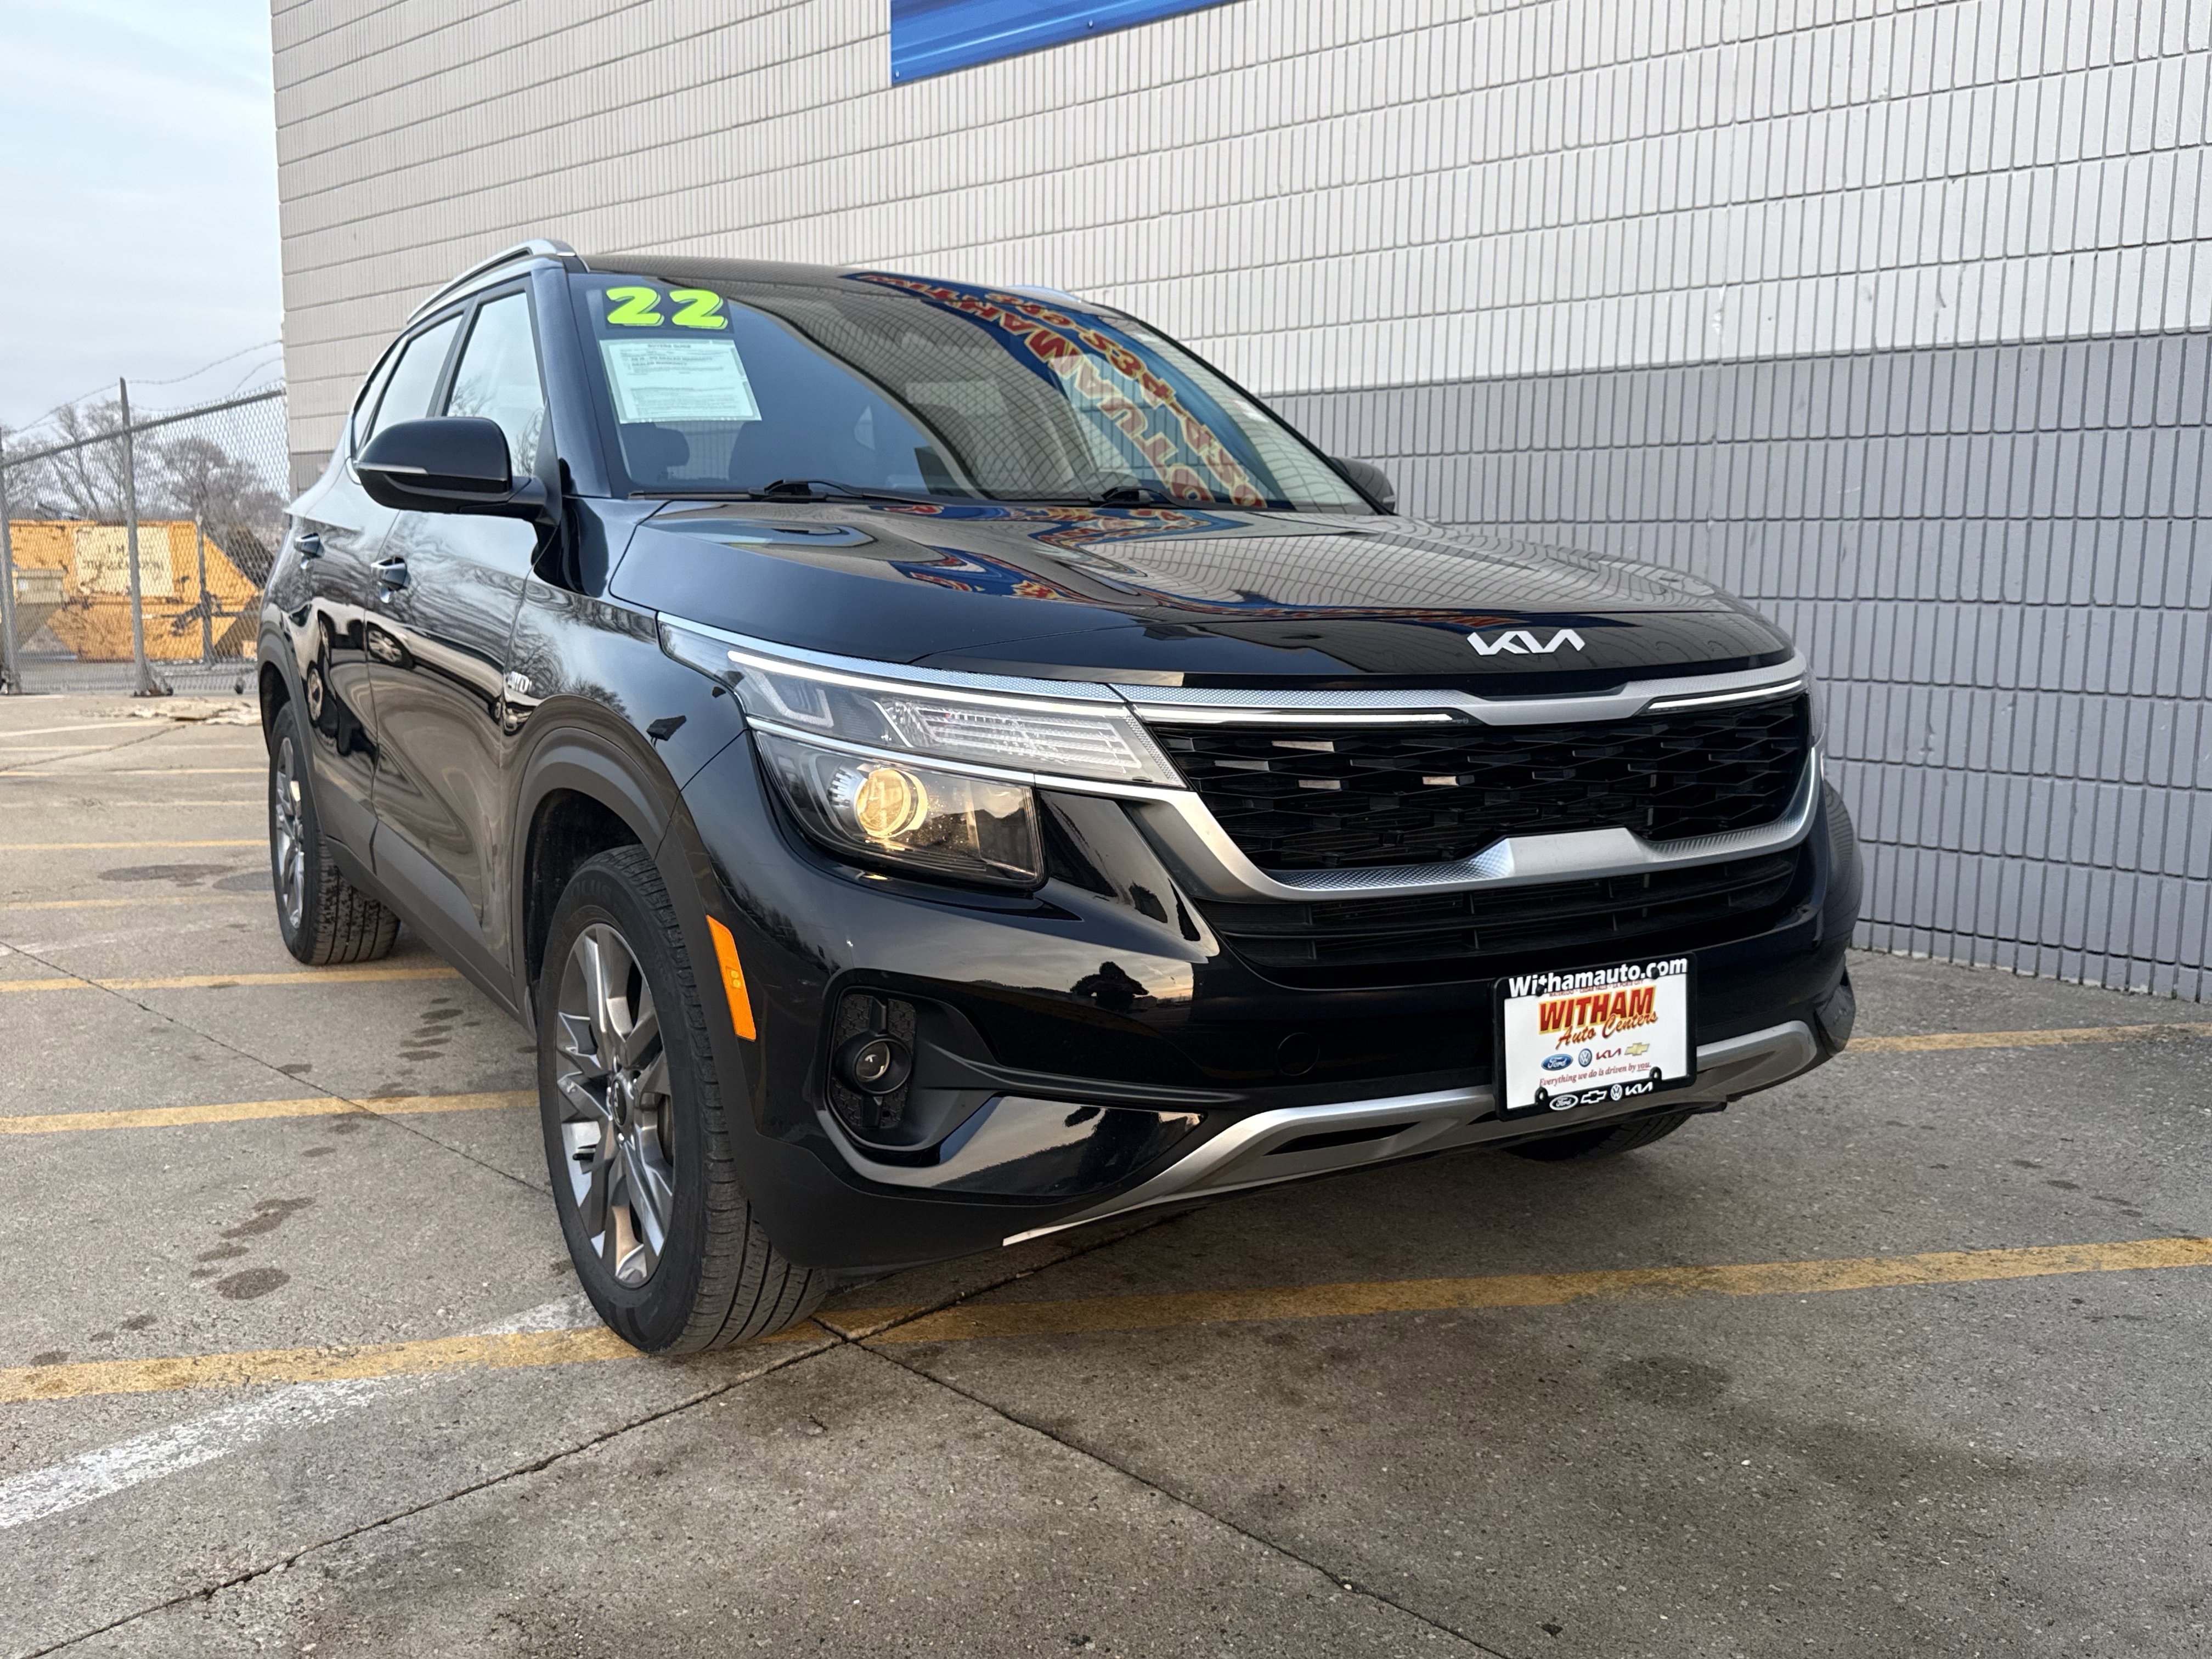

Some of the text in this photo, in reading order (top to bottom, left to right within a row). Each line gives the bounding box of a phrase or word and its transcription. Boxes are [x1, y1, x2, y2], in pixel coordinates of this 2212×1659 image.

[606, 286, 729, 329] 22
[1466, 629, 1585, 656] KIA
[1509, 958, 1688, 998] Withamauto.com
[1538, 986, 1656, 1034] WITHAM
[1555, 1010, 1658, 1050] Auto Centers
[1596, 1047, 1621, 1060] KIA
[1539, 1075, 1577, 1087] Everything
[1588, 1069, 1597, 1077] do
[1605, 1064, 1627, 1075] driven
[1628, 1063, 1636, 1073] by
[1625, 1081, 1653, 1096] KIA
